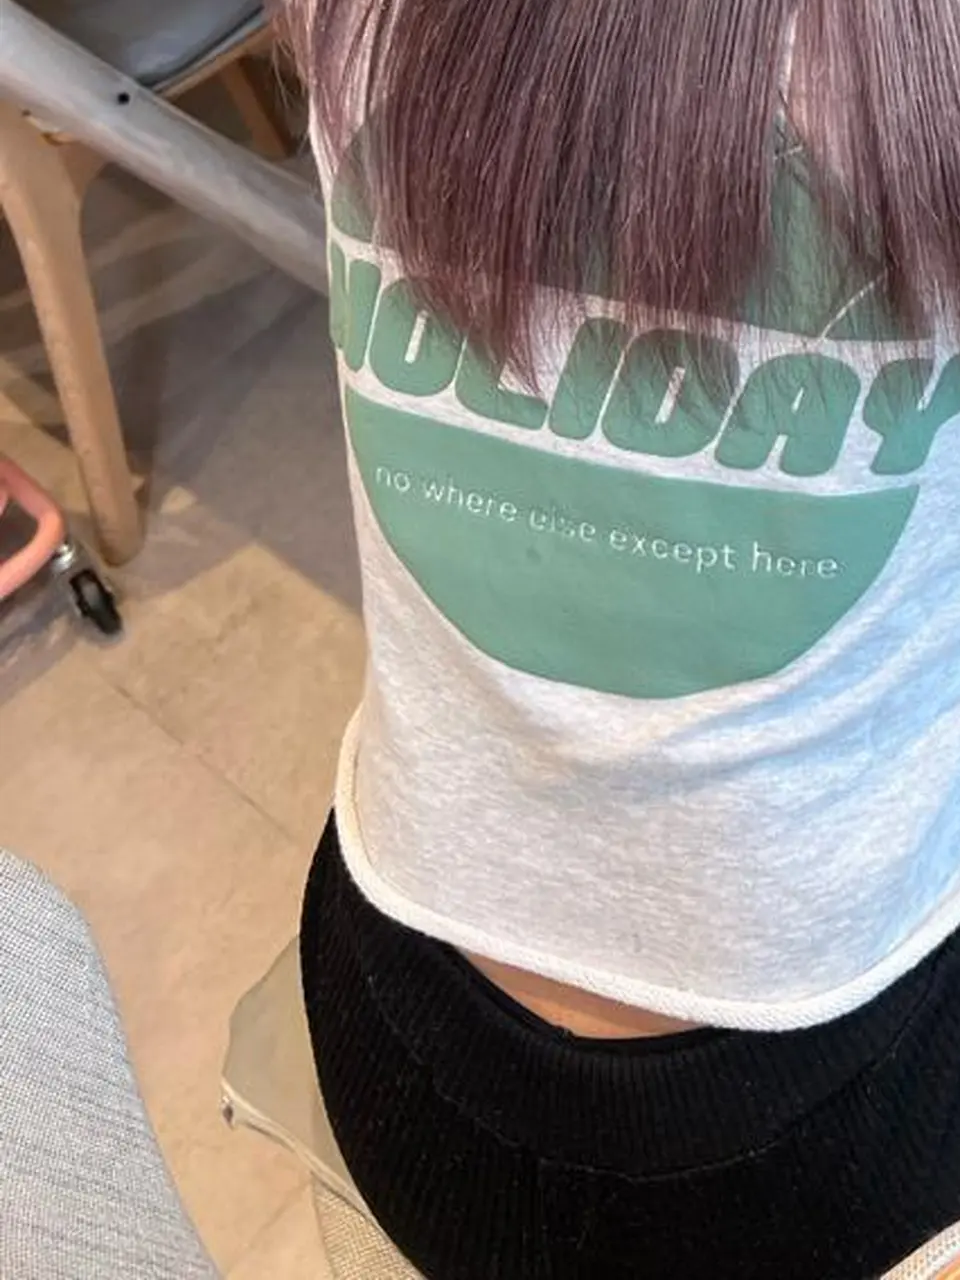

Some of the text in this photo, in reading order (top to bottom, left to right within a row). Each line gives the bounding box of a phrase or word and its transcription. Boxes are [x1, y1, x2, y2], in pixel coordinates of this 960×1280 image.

[375, 465, 411, 493] no
[423, 477, 517, 522] where
[608, 528, 736, 574] except
[751, 540, 838, 579] here
